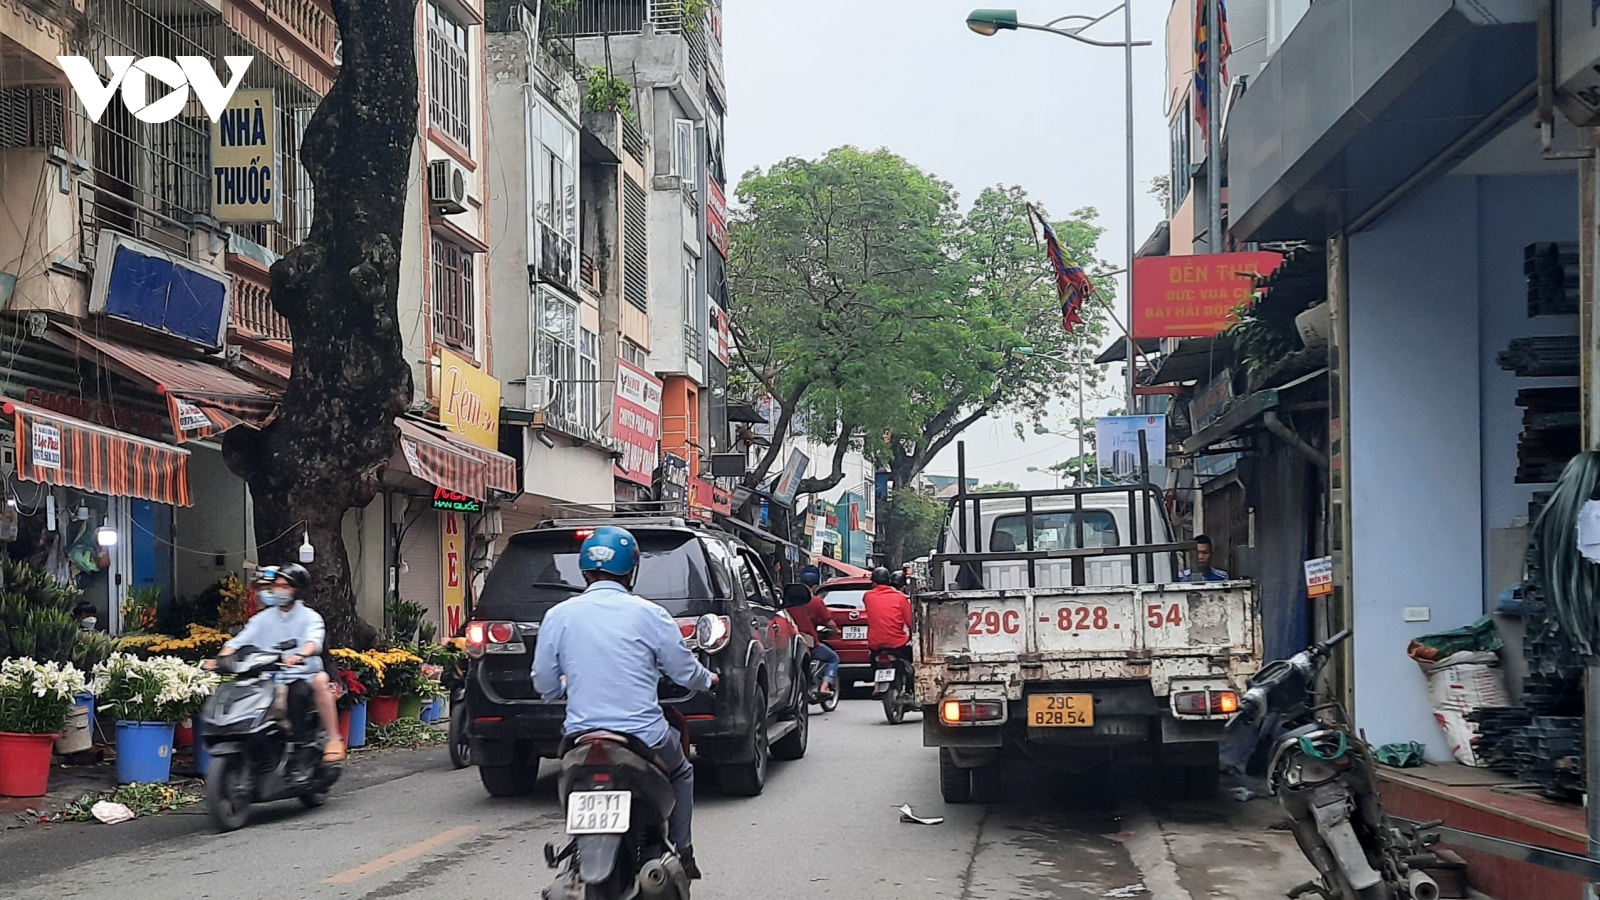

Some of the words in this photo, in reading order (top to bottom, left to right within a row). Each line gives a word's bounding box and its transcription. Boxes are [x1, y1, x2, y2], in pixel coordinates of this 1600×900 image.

[220, 99, 266, 147] NHÀ
[214, 155, 271, 205] THUỐC
[1168, 259, 1209, 285] ĐỀN
[1199, 287, 1228, 300] VUA
[444, 366, 482, 433] Rèm
[967, 609, 1020, 636] 29C
[1147, 603, 1183, 629] 54
[1047, 696, 1075, 710] 29C
[1035, 711, 1086, 725] 828.54
[578, 794, 621, 812] 30-Y1
[576, 812, 620, 829] 2887
